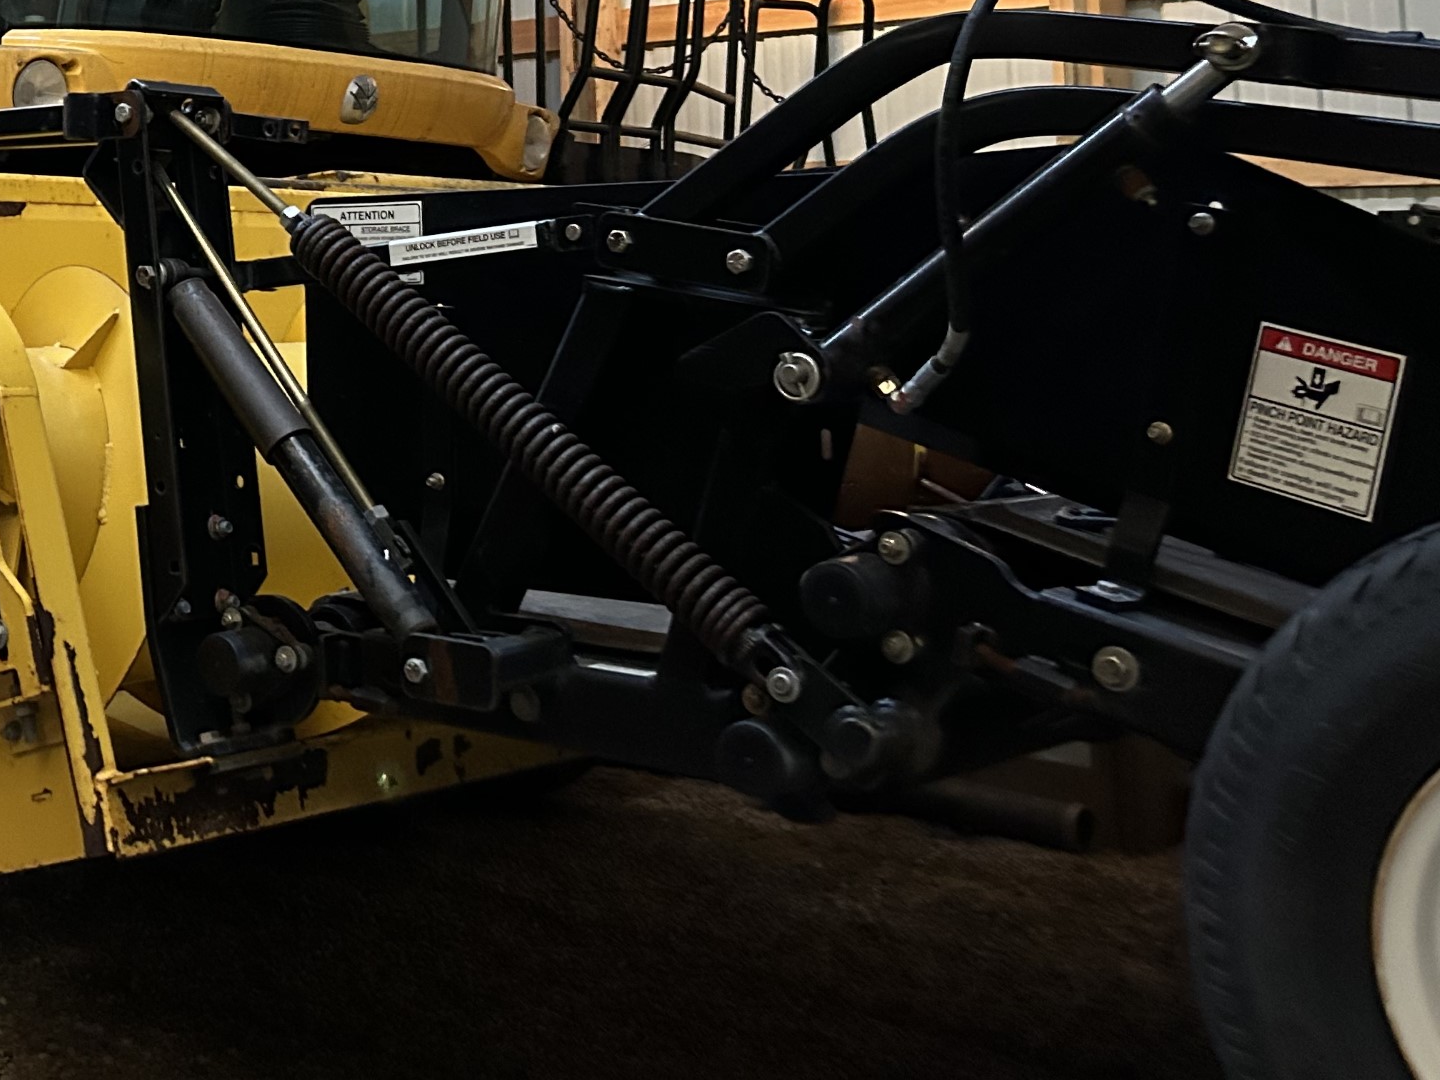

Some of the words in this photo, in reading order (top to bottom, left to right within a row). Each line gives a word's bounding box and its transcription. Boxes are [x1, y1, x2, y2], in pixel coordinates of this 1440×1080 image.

[340, 210, 395, 220] ATTENTION
[405, 241, 435, 252] UNLOCK
[437, 236, 466, 248] BEFORE
[468, 234, 489, 244] FIELD
[490, 232, 506, 241] USE
[1302, 342, 1378, 372] DANGER
[1250, 402, 1286, 421] PINCH
[1287, 412, 1325, 431] POINT
[1327, 422, 1379, 446] HAZARD
